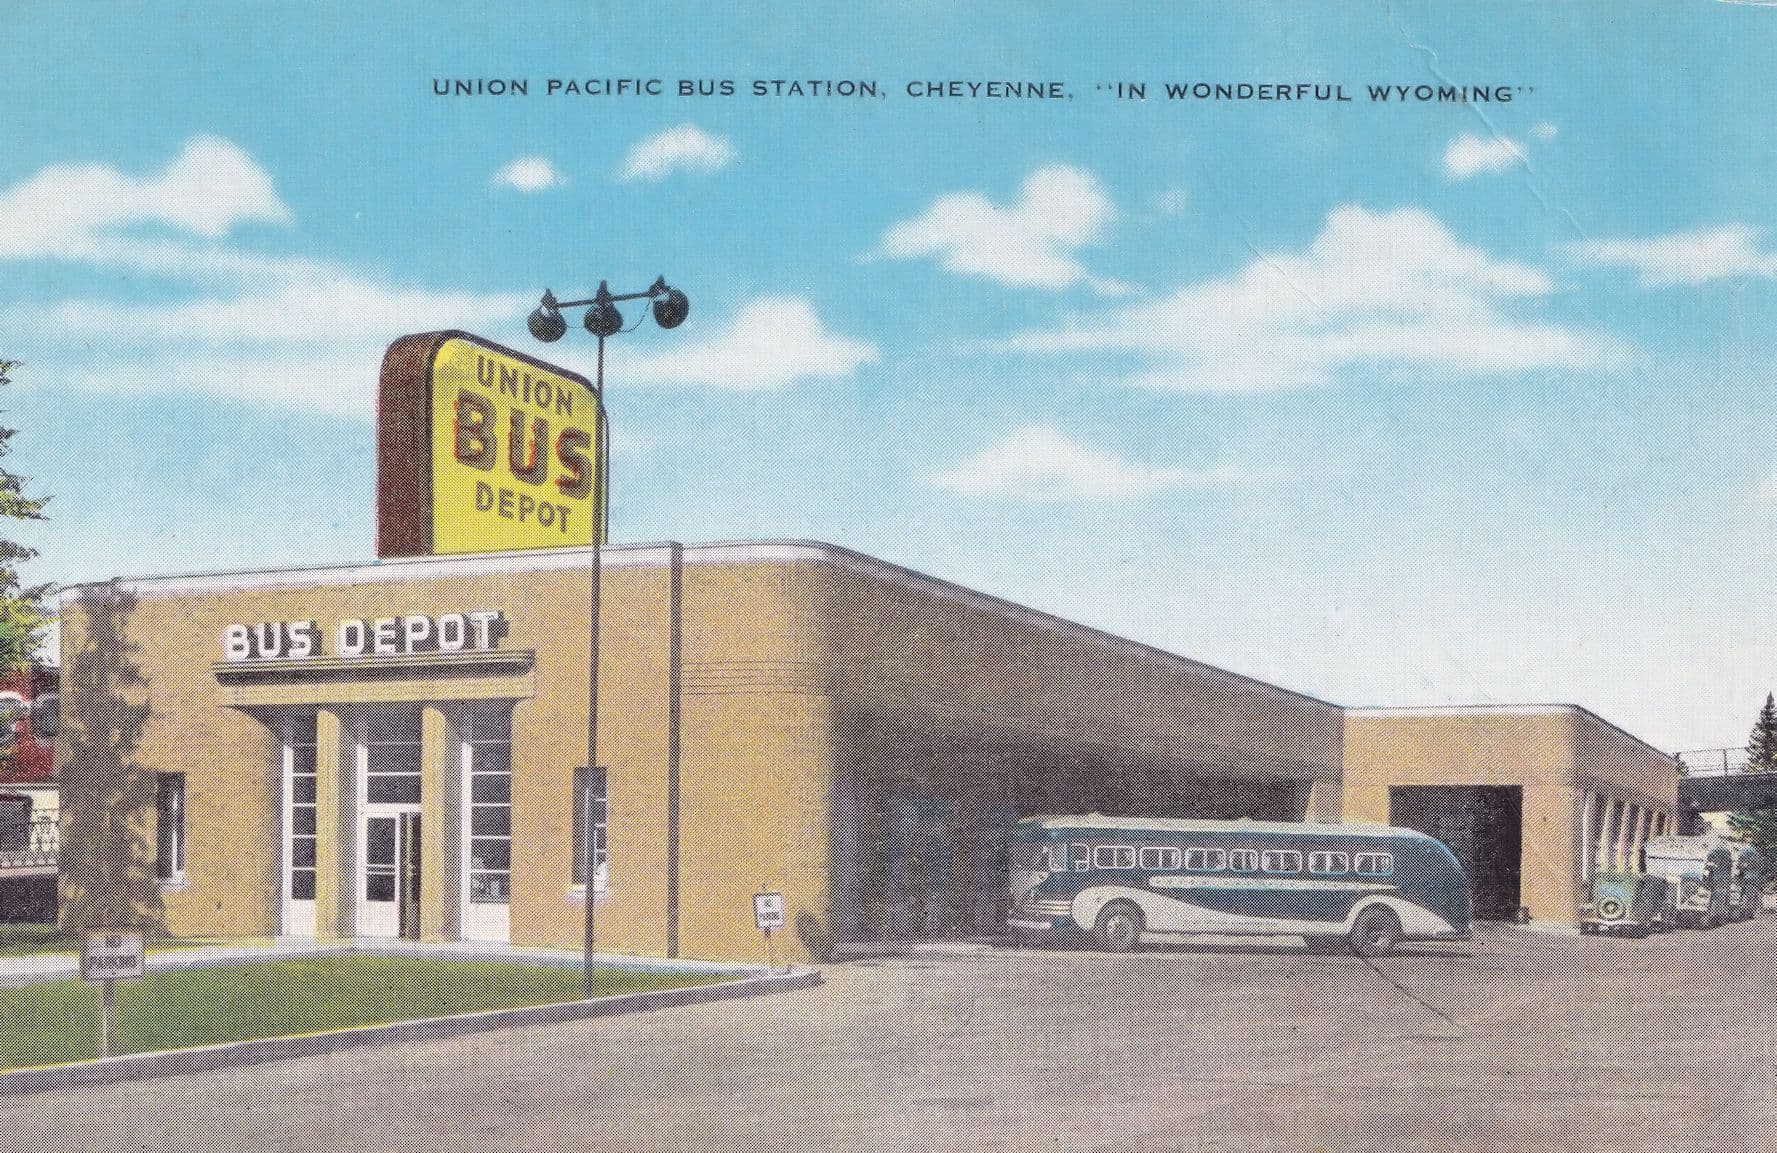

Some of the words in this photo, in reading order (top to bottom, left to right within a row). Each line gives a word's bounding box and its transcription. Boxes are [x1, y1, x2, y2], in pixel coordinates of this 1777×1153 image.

[476, 355, 573, 416] UNION
[453, 387, 594, 500] BUS
[474, 480, 573, 533] DEPOT
[220, 617, 317, 661] BUS
[335, 607, 502, 659] DEPOT
